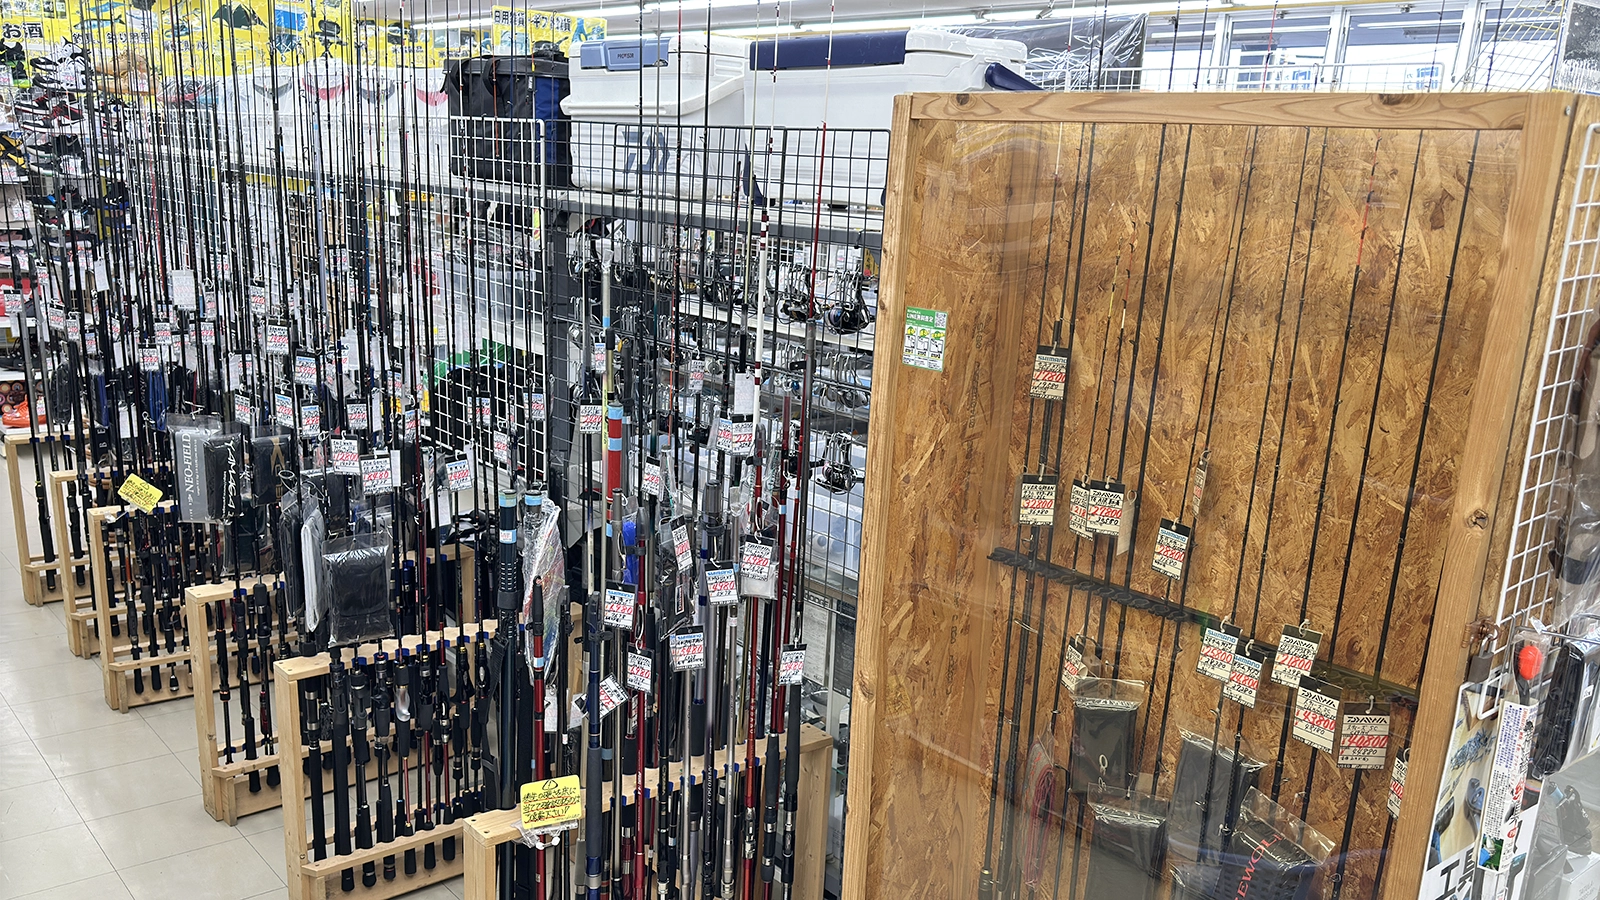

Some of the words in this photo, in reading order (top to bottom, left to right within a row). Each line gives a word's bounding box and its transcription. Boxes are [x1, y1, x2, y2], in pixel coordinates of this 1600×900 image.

[3, 22, 44, 39] お酒
[1038, 355, 1067, 364] SHIMANO
[736, 433, 753, 443] 228
[182, 432, 195, 493] NEO-FIELD
[1093, 490, 1122, 500] DAIWA
[1075, 506, 1086, 517] 218
[1161, 530, 1187, 543] SHIMANO
[608, 590, 634, 599] SHIMANO
[1207, 629, 1236, 643] SHIMANO
[1284, 637, 1314, 650] DAIWA
[1234, 656, 1261, 669] SHIMANO
[1301, 690, 1336, 707] DAIWA
[1347, 716, 1388, 724] DAIWA
